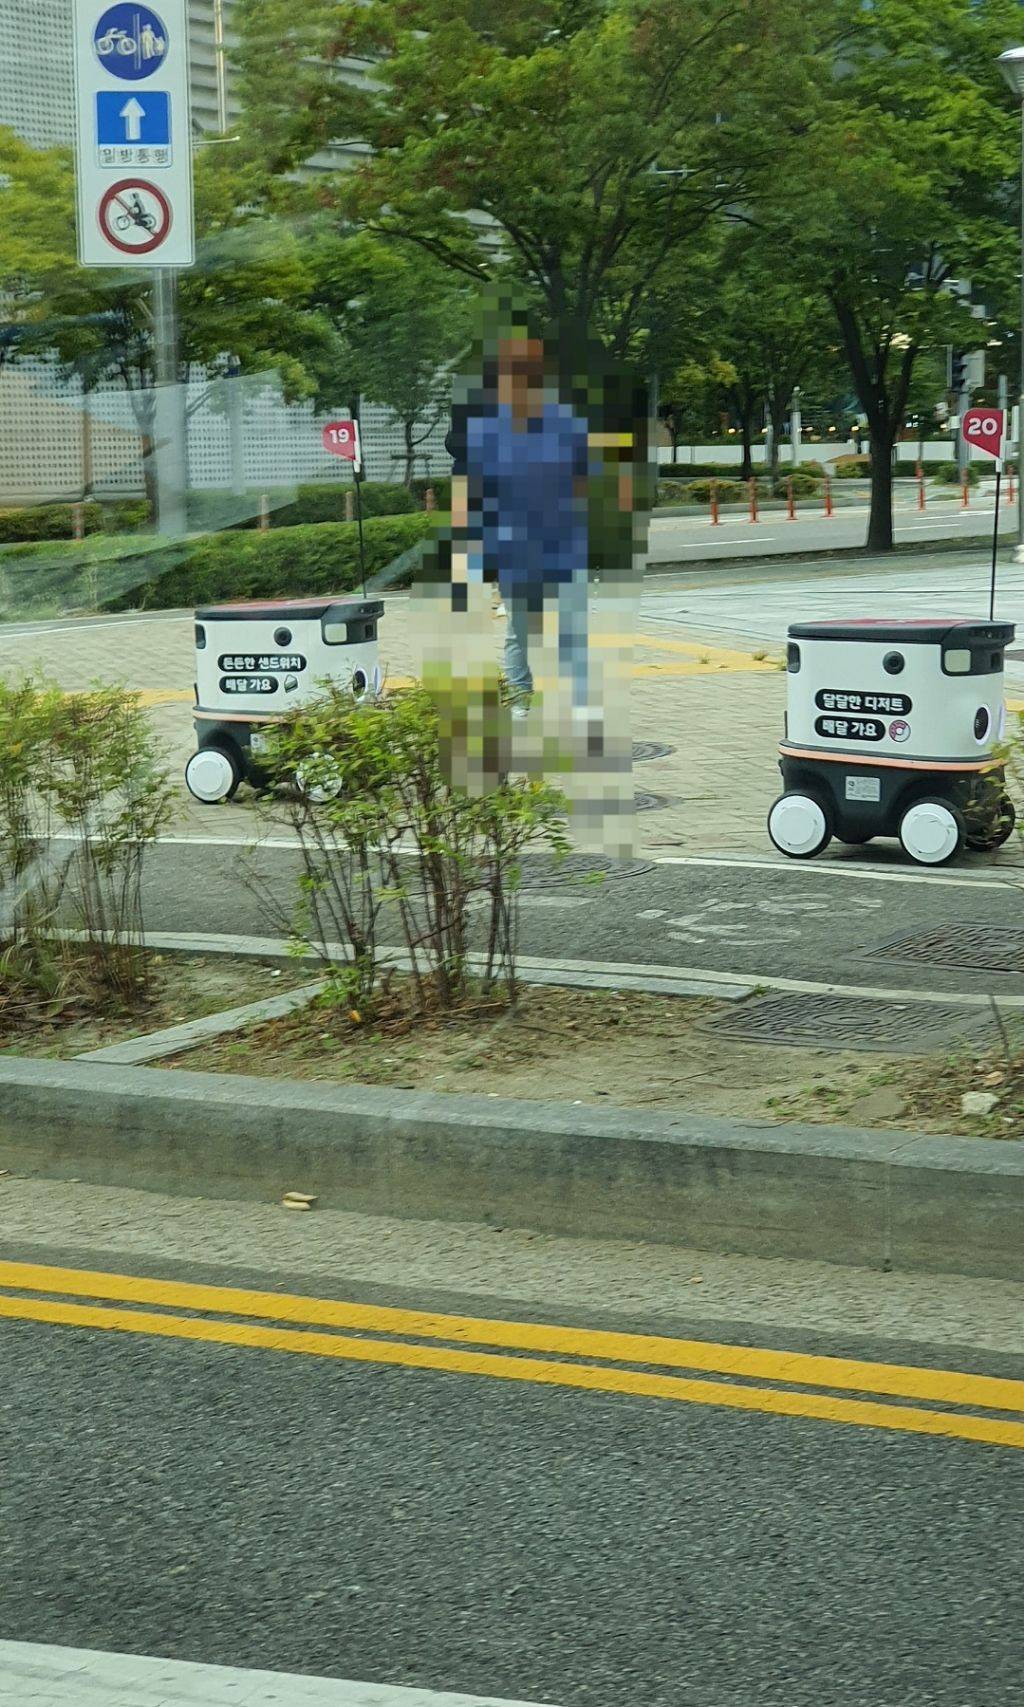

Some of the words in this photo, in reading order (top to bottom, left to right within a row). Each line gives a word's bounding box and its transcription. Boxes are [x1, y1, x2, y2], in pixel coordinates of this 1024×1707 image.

[103, 148, 168, 163] 일반통행
[968, 417, 998, 435] 20
[330, 428, 350, 443] 19
[223, 657, 255, 670] 든든한
[258, 657, 301, 670] 샌드위치
[225, 678, 247, 691] 배달
[249, 678, 271, 691] 가요
[823, 693, 861, 710] 달달한
[864, 696, 904, 711] 디저트
[822, 719, 848, 736] 배달
[851, 721, 877, 736] 가요
